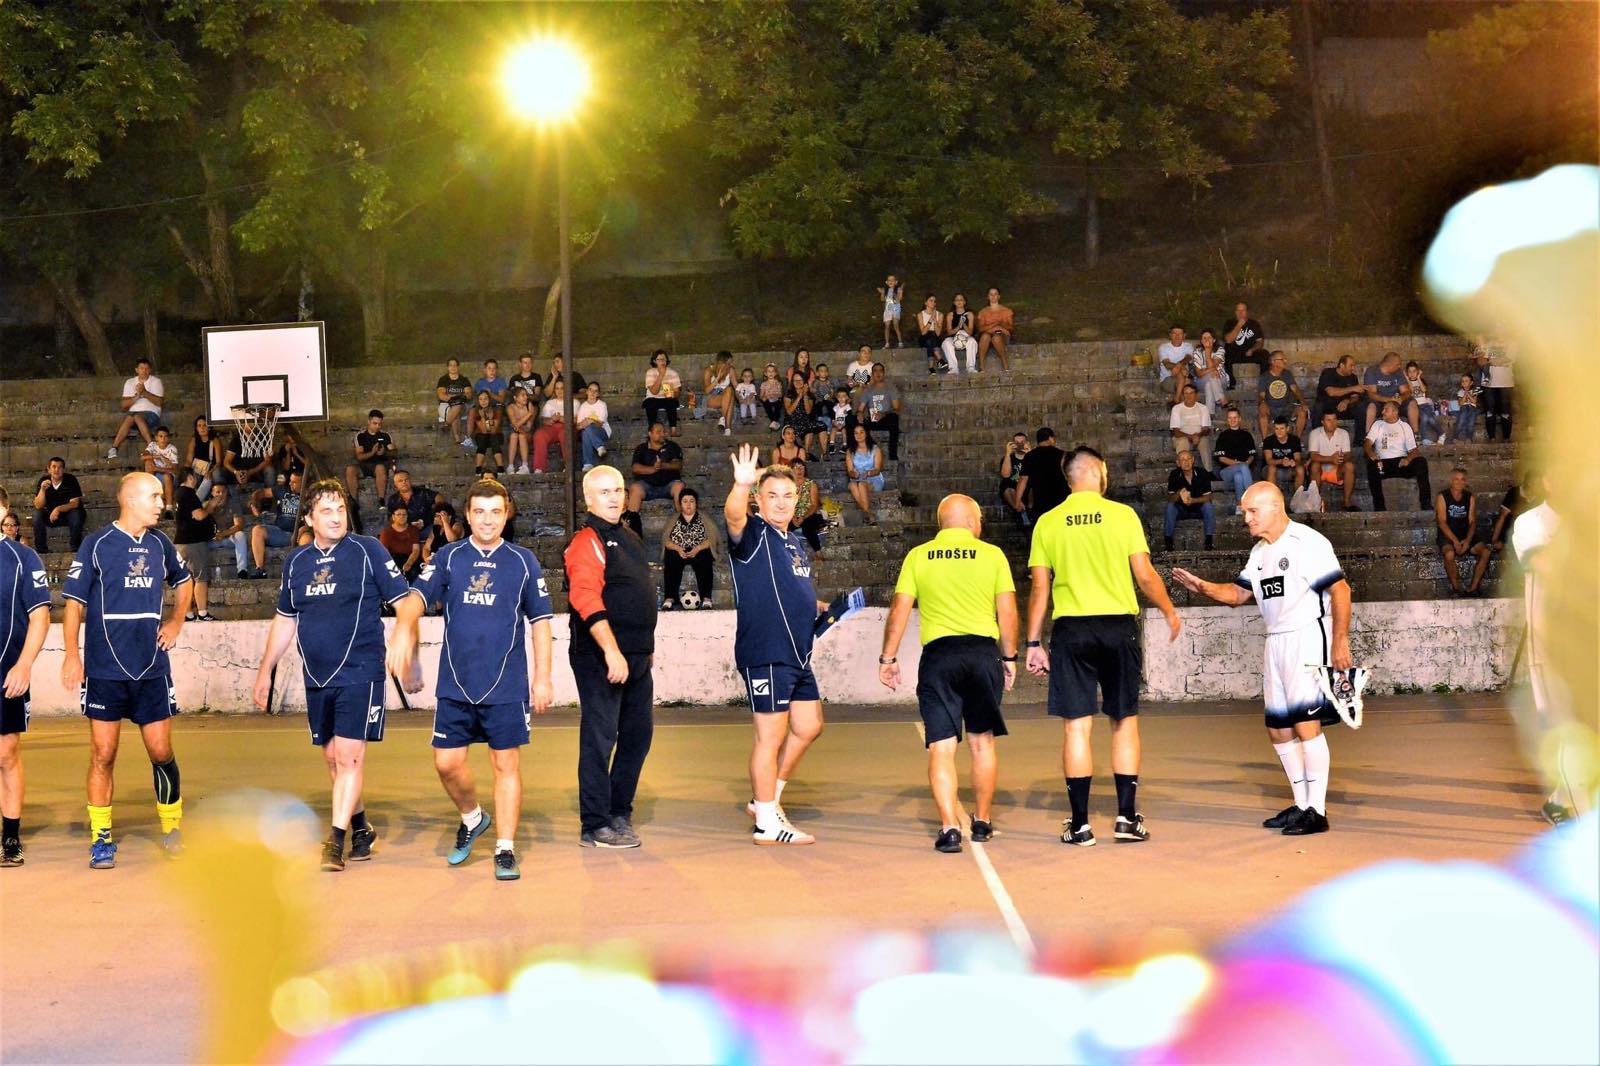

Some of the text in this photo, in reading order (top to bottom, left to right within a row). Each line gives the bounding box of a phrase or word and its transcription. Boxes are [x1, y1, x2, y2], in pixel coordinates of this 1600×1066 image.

[1066, 512, 1102, 526] SUZIĆ
[927, 547, 977, 560] UROŠEV
[124, 576, 153, 588] LAV
[305, 583, 337, 596] LAV
[463, 591, 497, 605] LAV
